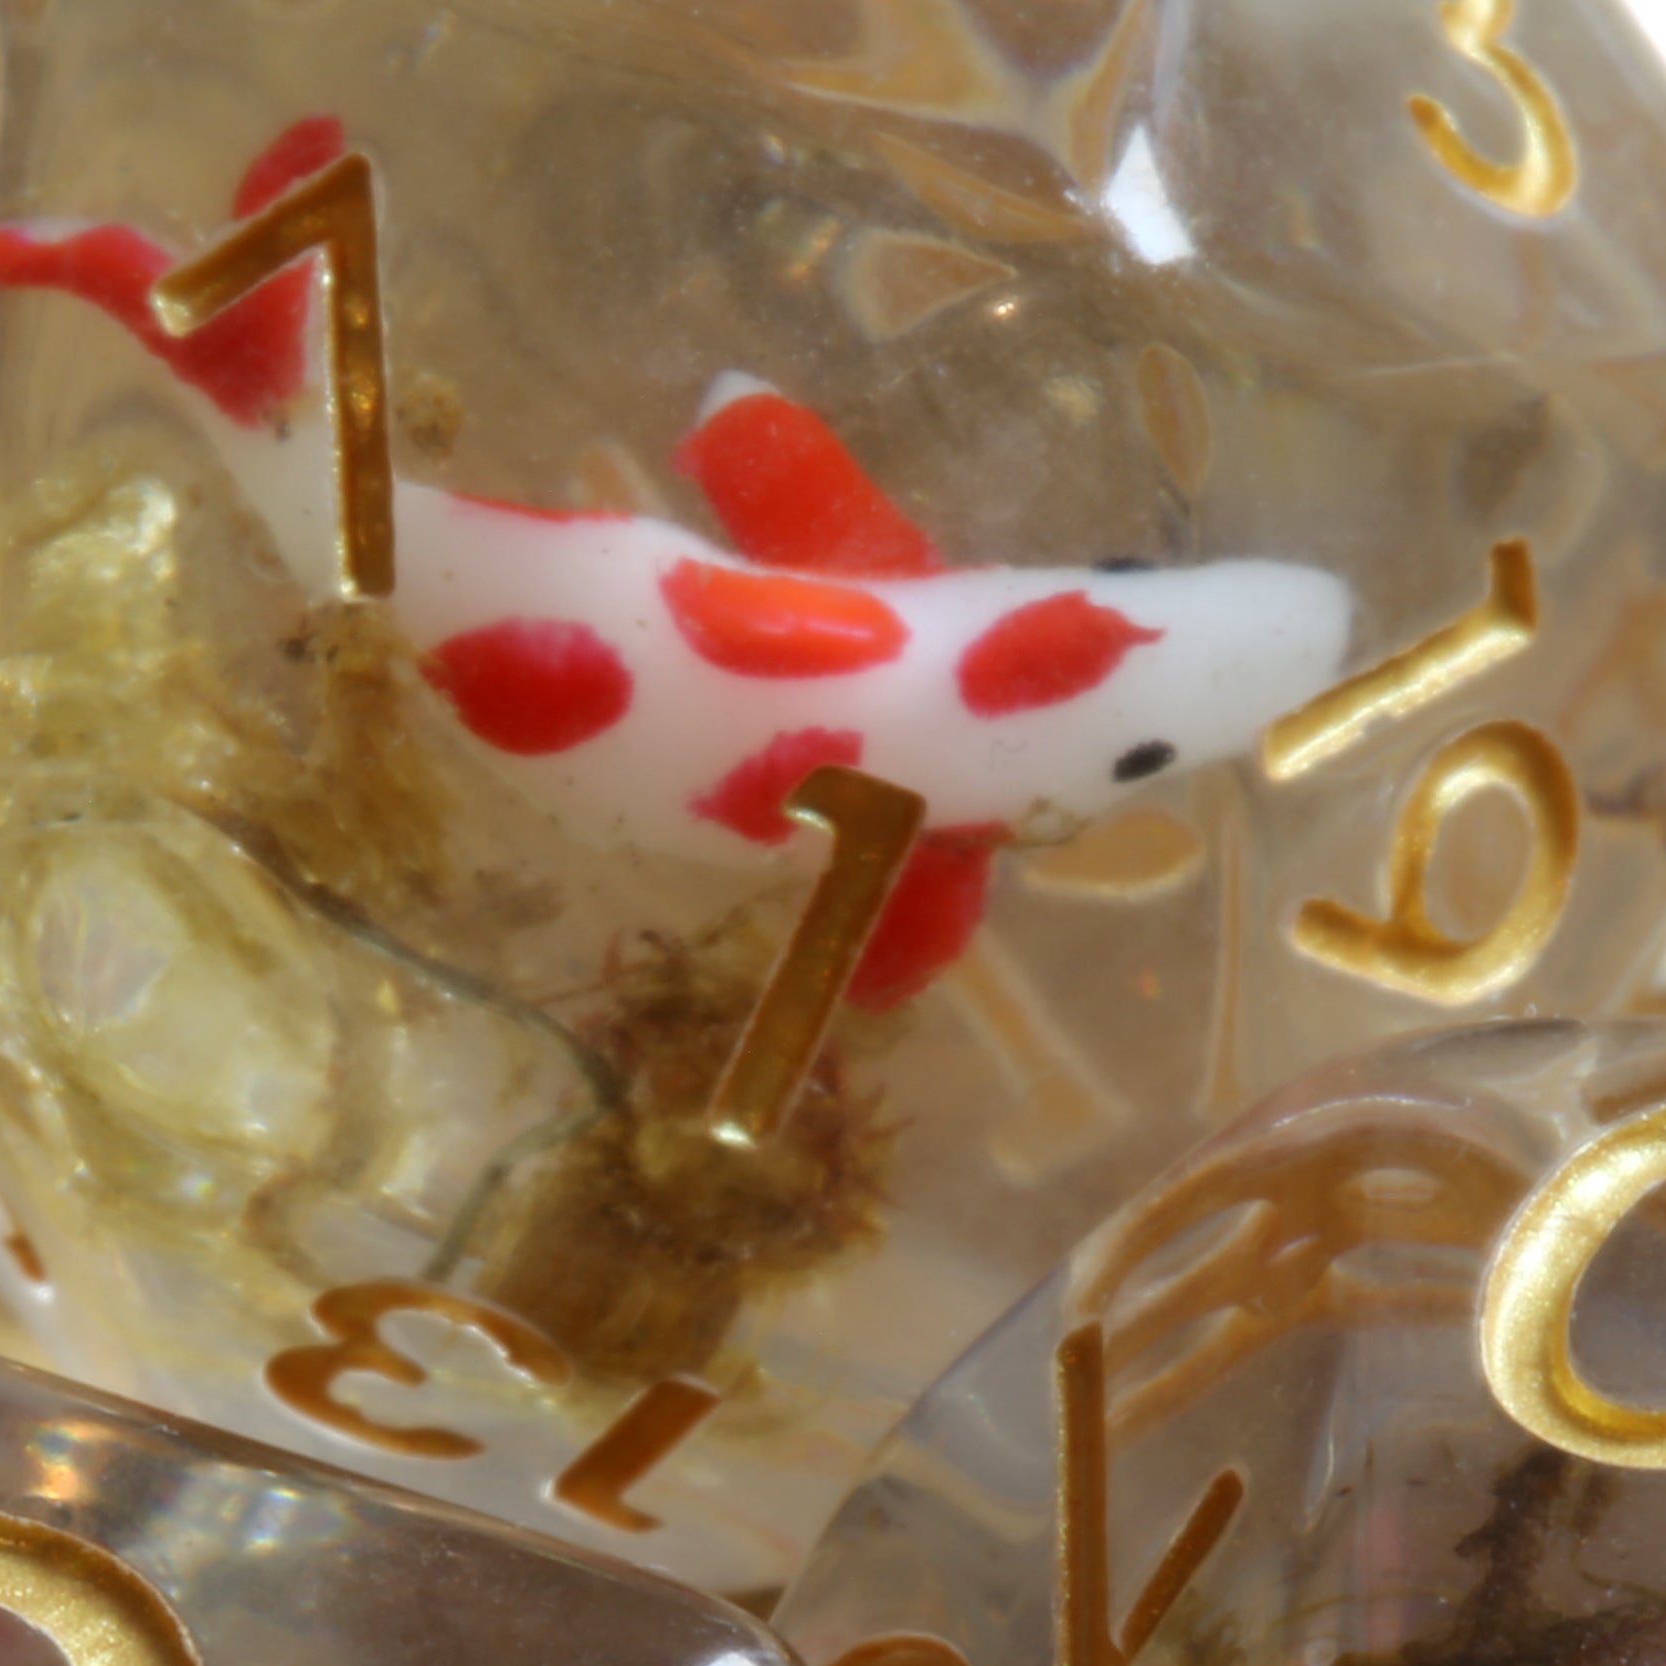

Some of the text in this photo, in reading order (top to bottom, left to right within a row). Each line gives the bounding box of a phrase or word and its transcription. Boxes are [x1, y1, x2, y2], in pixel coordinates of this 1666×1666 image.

[153, 152, 395, 602] 7
[711, 765, 927, 1148] 1
[1263, 537, 1579, 1001] 19
[265, 1277, 720, 1534] 13
